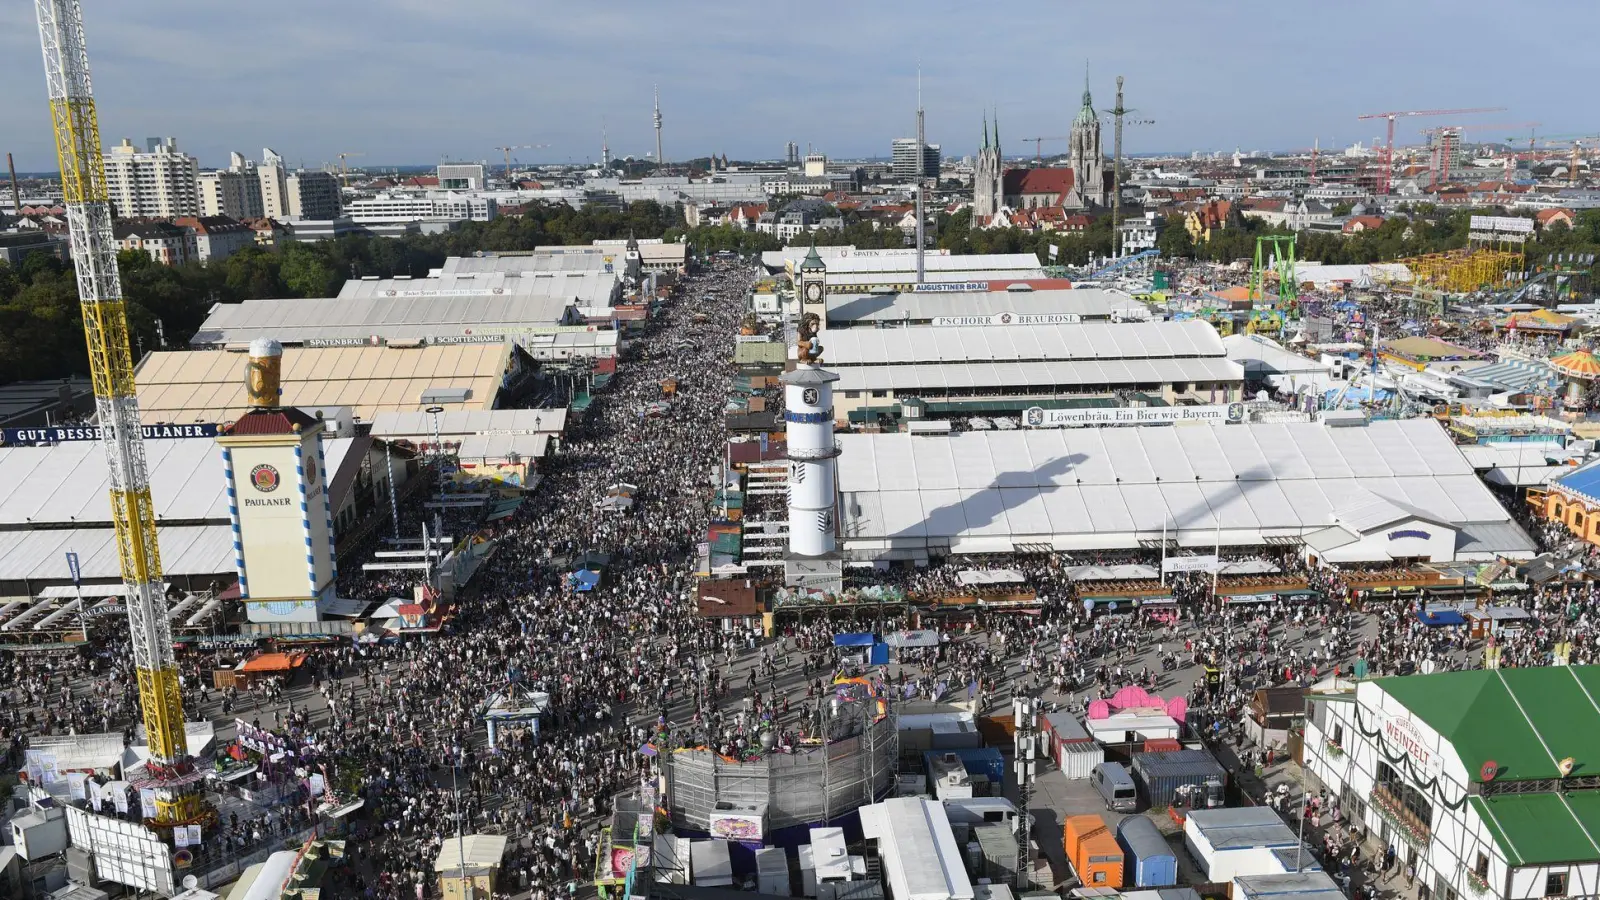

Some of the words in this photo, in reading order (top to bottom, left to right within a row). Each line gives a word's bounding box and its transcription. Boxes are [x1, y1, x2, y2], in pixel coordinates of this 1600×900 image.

[966, 282, 988, 290] BRÄU
[940, 316, 992, 325] PSCHORR
[1018, 314, 1075, 324] BRÄUROSL
[437, 335, 504, 344] SCHOTTENHAMEL
[1049, 411, 1112, 423] Löwenbräu.
[1115, 410, 1133, 420] Ein
[1137, 409, 1159, 420] Bier
[1161, 409, 1179, 419] wie
[1182, 408, 1222, 421] Bayern.
[17, 430, 53, 441] GUT,
[141, 426, 209, 438] ULANER.
[244, 497, 292, 507] PAULANER
[1386, 720, 1430, 766] WEINZELT
